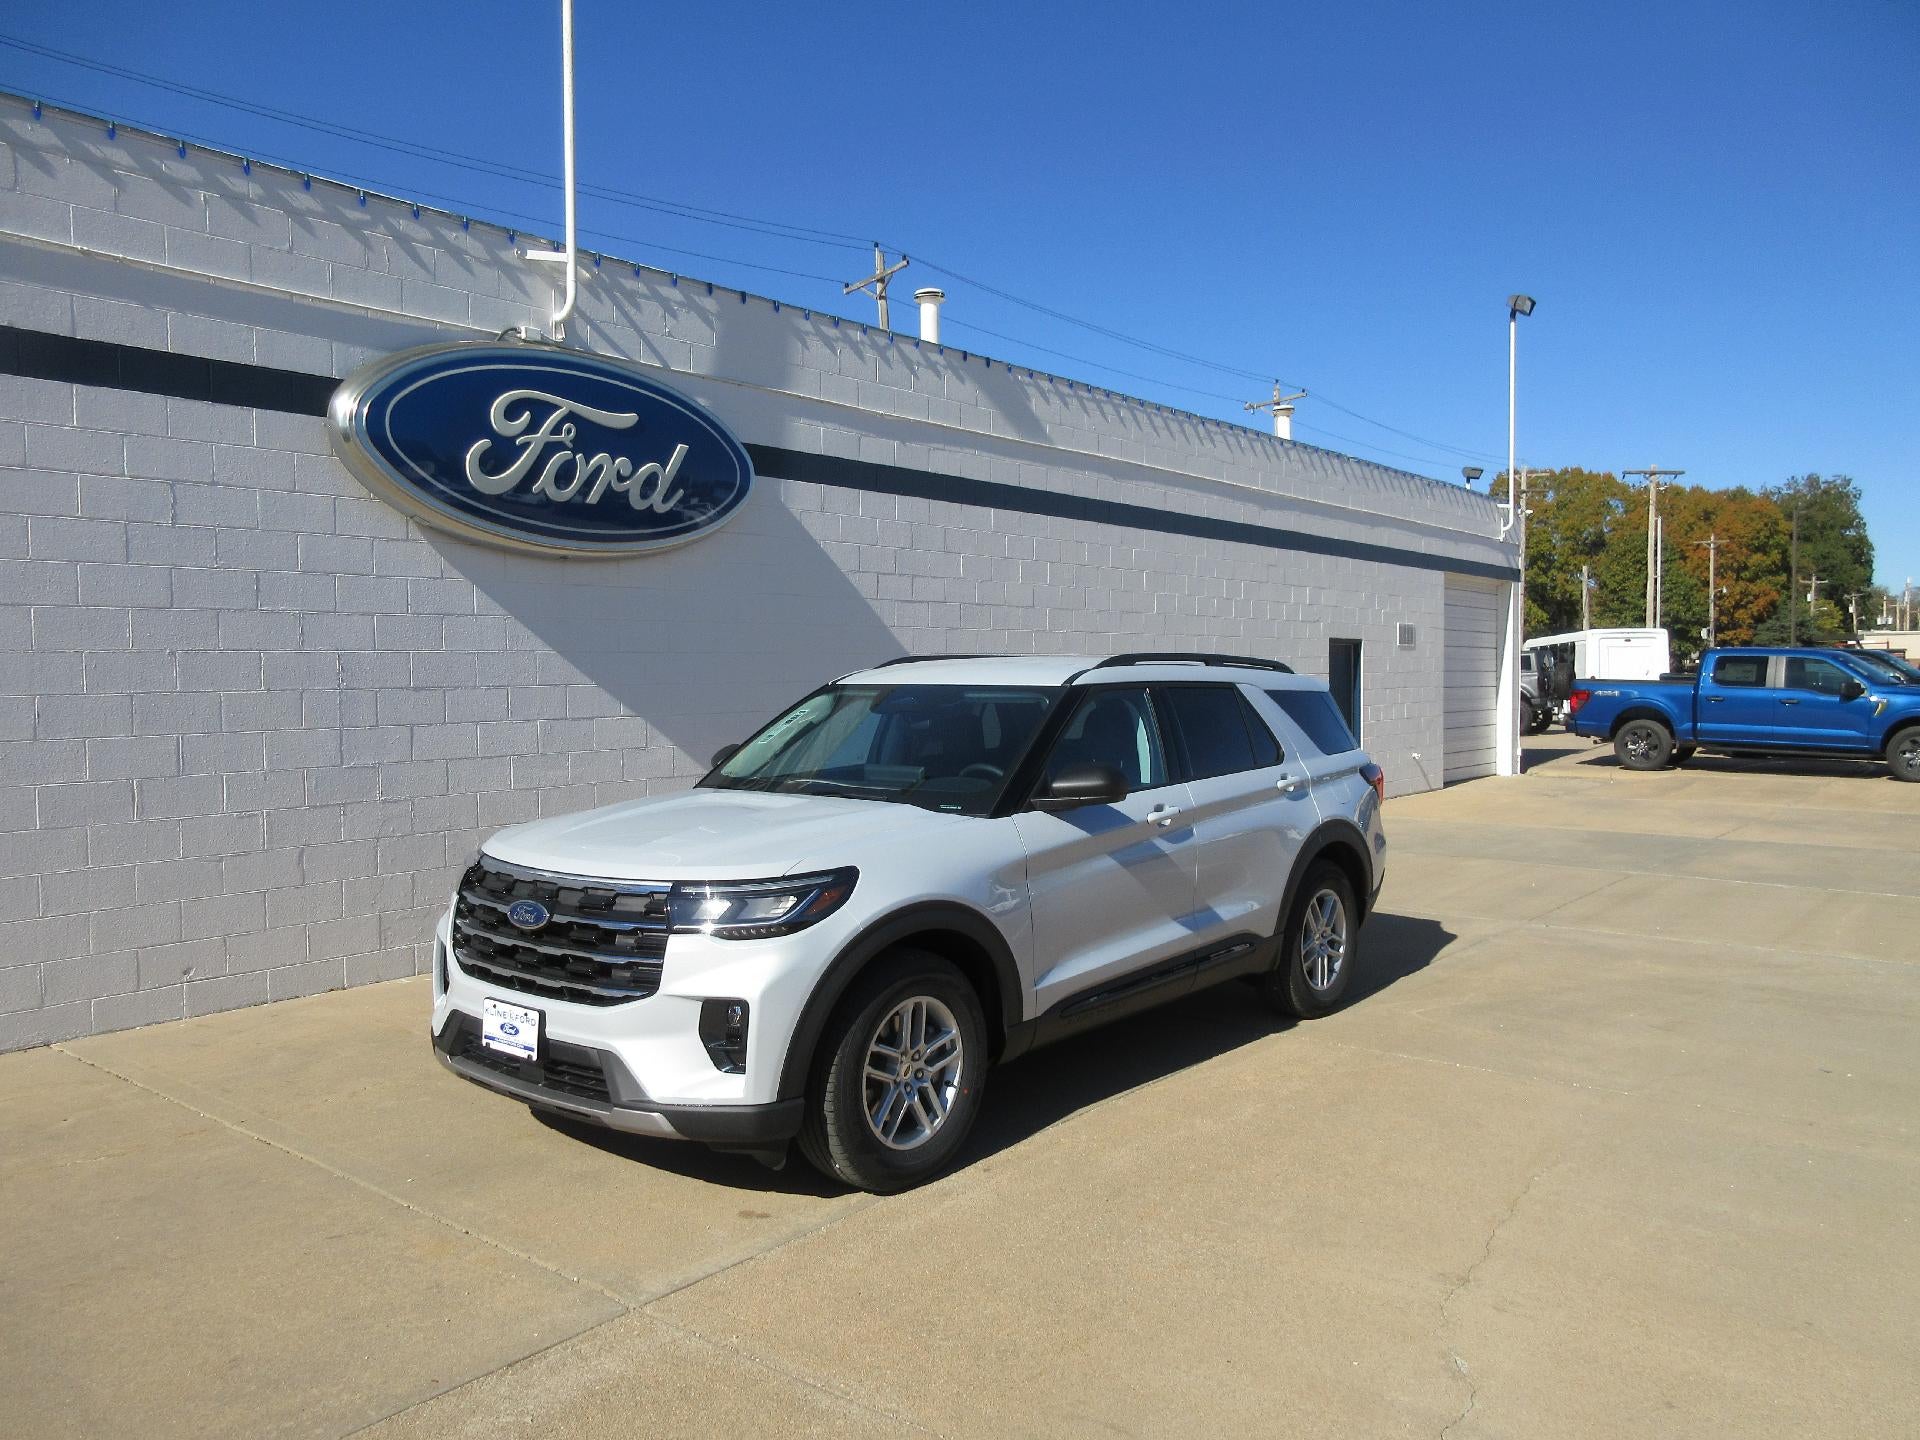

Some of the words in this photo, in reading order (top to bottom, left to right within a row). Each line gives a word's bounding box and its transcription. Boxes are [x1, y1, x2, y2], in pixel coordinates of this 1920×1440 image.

[465, 389, 689, 514] Ford
[513, 905, 537, 922] Ford
[485, 1007, 508, 1019] KLINE
[515, 1014, 536, 1026] FORD
